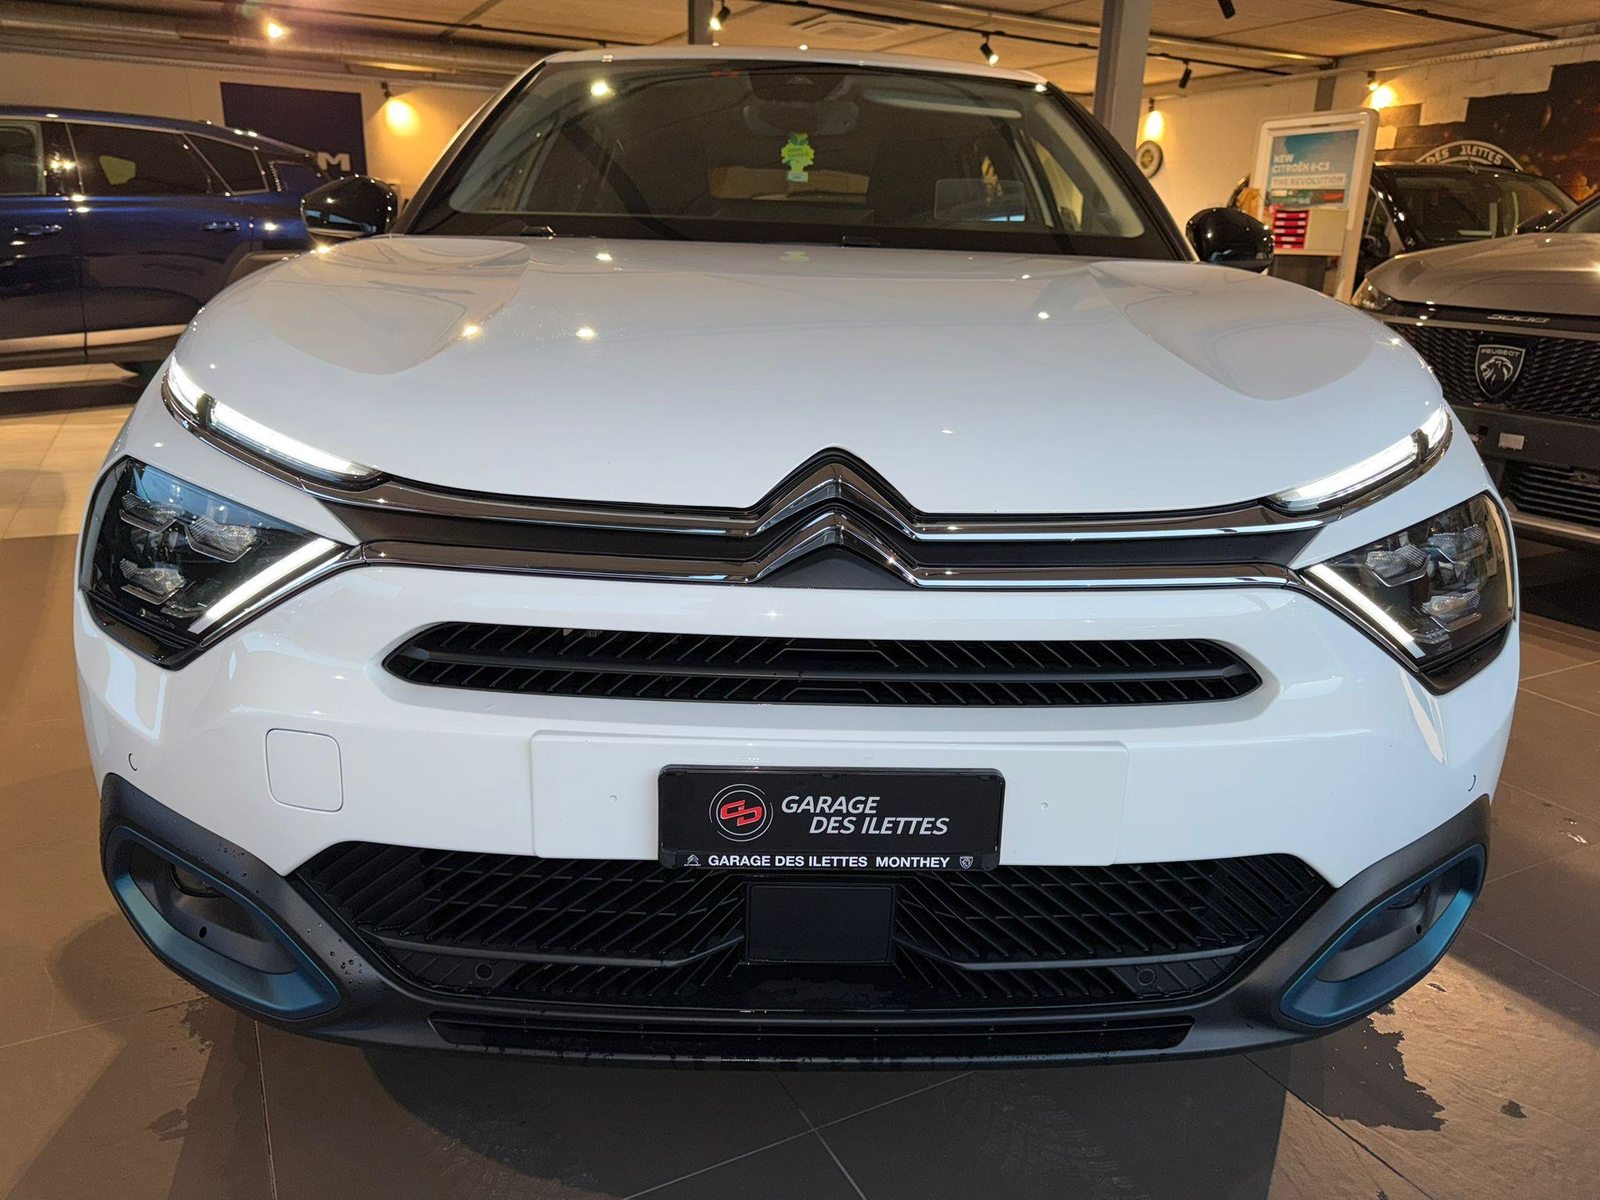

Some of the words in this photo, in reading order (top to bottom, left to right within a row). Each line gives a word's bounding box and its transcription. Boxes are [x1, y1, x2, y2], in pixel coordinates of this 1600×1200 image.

[1273, 154, 1295, 163] NEW
[1426, 148, 1450, 164] DES
[1273, 177, 1290, 186] THE
[1290, 175, 1344, 186] REVOLUTION
[1480, 348, 1520, 357] PEUGEOT
[781, 795, 880, 814] GARAGE
[809, 816, 856, 834] DES
[861, 817, 950, 836] ILETTES
[708, 855, 771, 867] GARAGE
[775, 855, 805, 867] DES
[808, 856, 868, 868] ILETTES
[875, 856, 950, 868] MONTHEY
